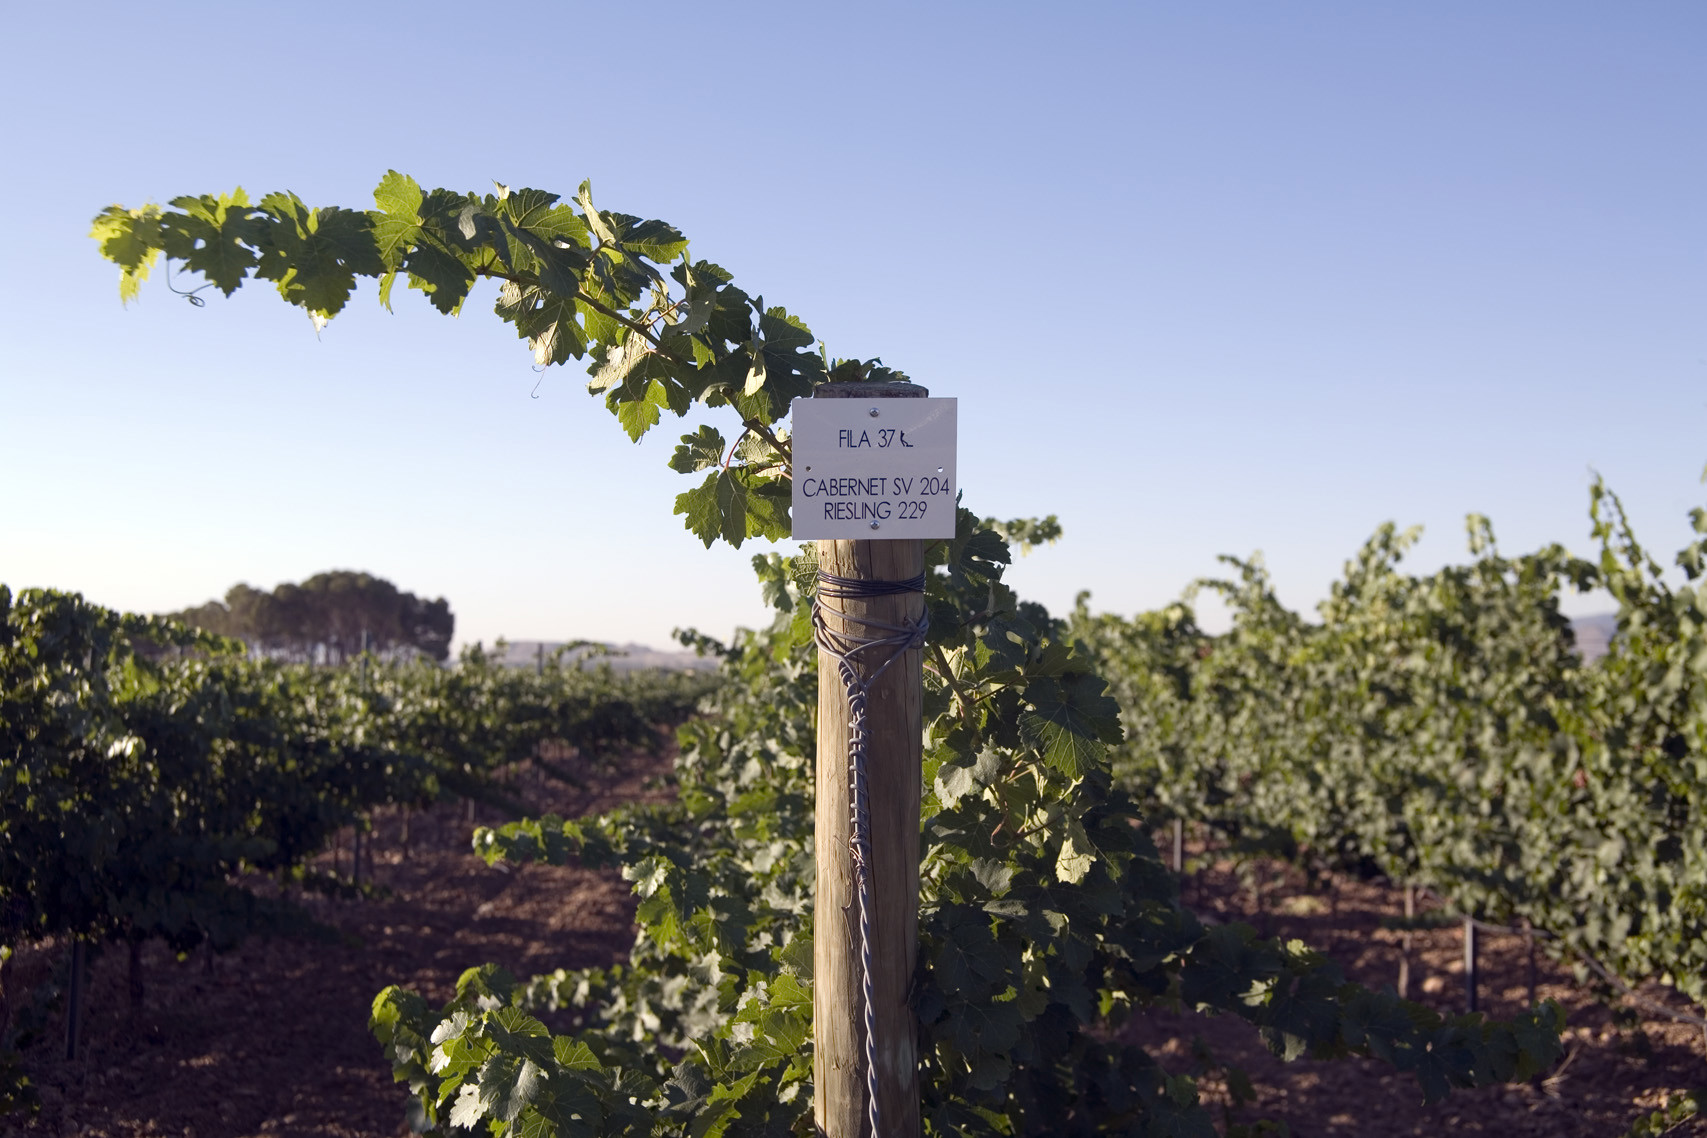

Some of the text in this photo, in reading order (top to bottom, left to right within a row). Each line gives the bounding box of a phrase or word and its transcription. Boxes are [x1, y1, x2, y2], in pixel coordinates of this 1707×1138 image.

[839, 429, 872, 448] FILA
[802, 476, 950, 498] CABERNET SV 204
[824, 501, 928, 520] RIESLING 229
